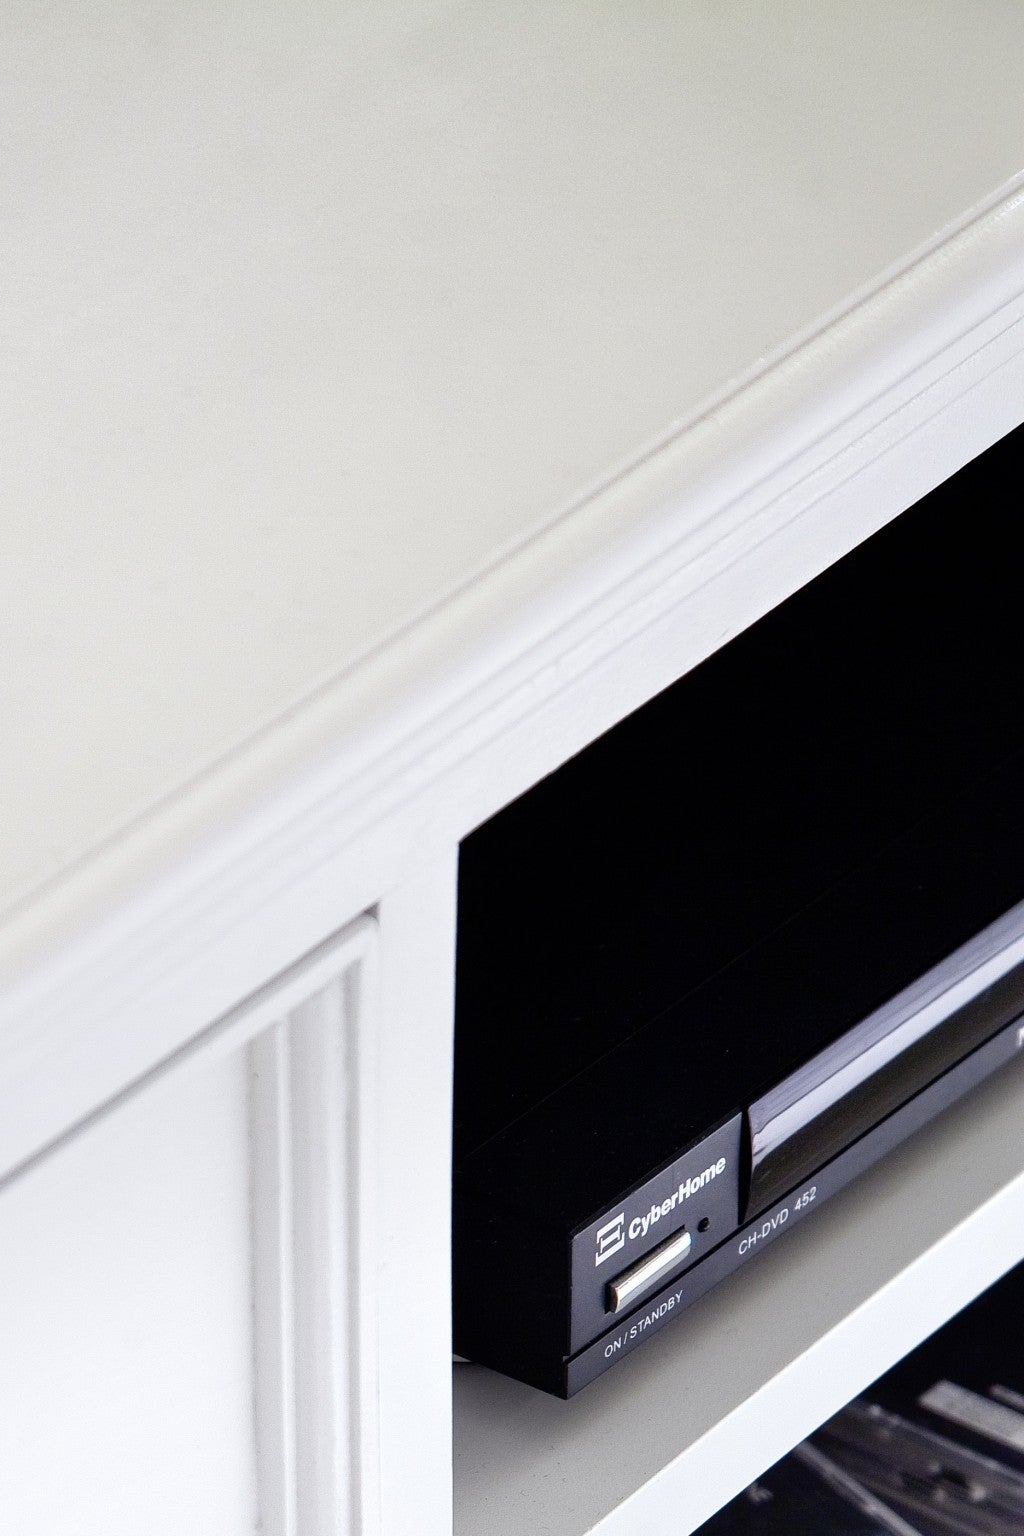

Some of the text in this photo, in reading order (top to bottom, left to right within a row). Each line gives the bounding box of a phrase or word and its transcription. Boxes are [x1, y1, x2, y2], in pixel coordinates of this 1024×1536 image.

[628, 1157, 727, 1240] CyberHome
[738, 1186, 818, 1256] CH-DVD 452
[604, 1337, 622, 1359] ON
[630, 1290, 684, 1340] STANDBY
